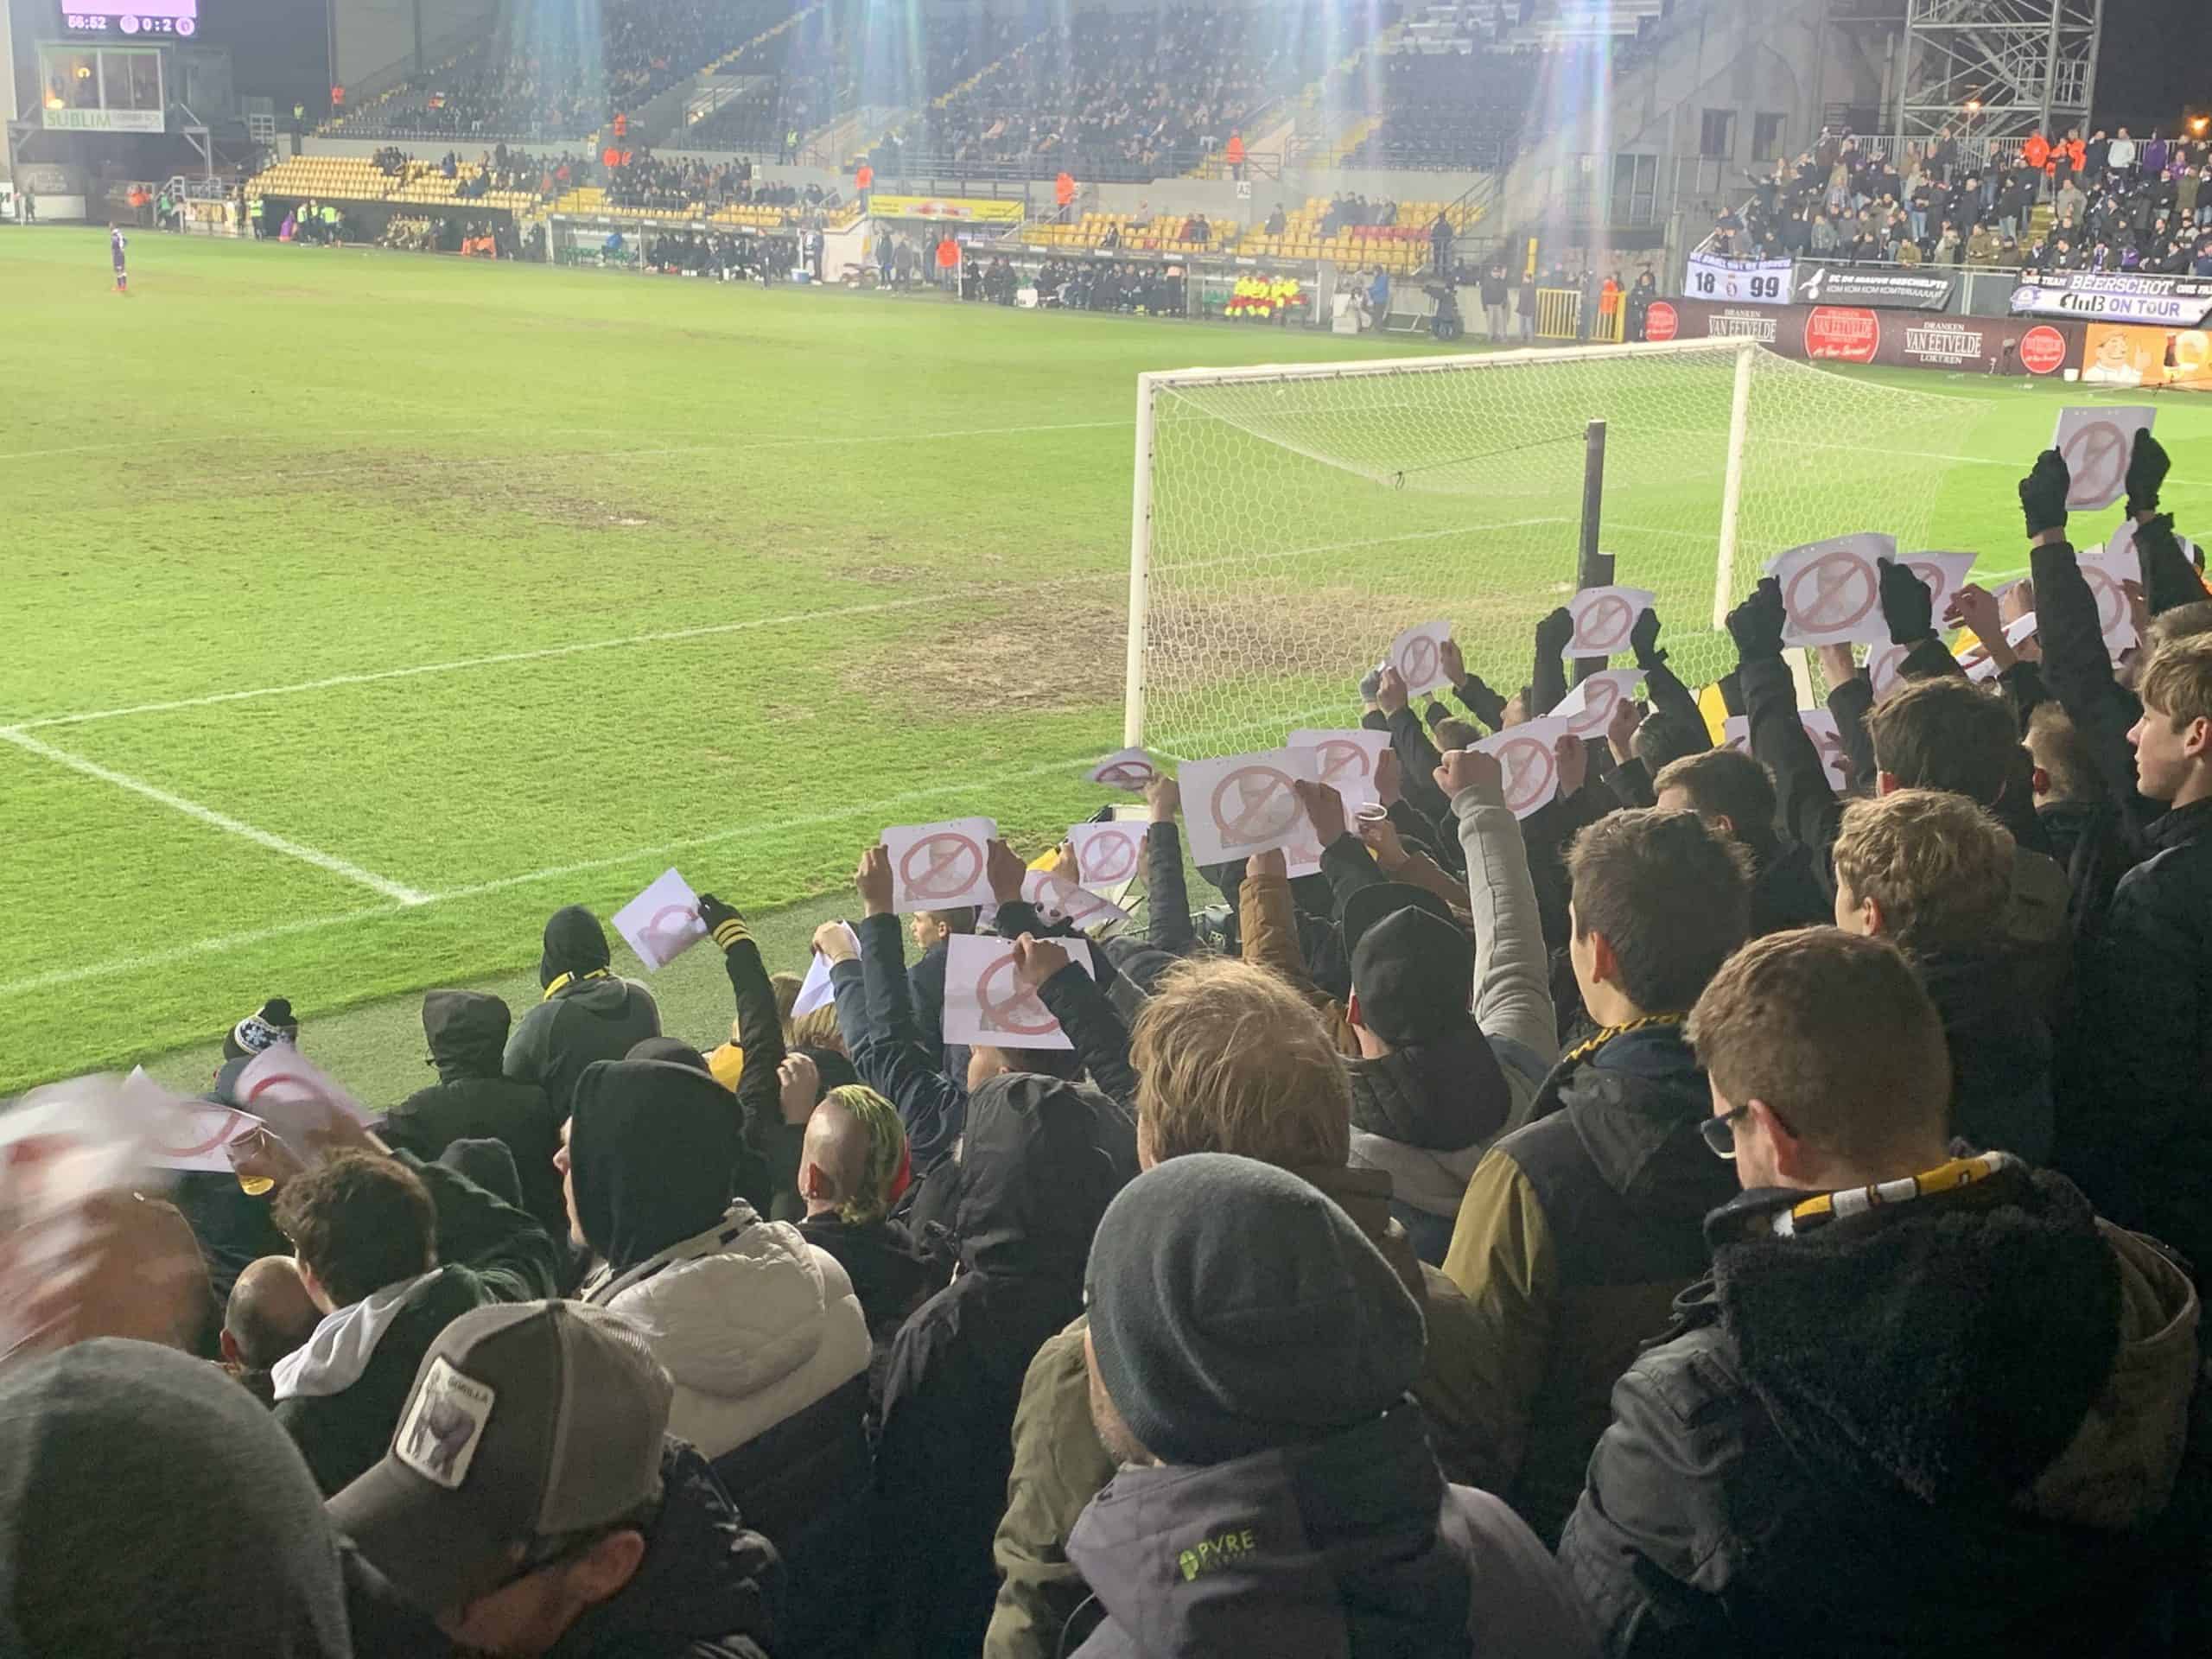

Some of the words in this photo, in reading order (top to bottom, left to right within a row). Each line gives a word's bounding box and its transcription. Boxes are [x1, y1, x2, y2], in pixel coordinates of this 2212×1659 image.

[46, 111, 112, 129] SUBLIM
[1695, 271, 1715, 294] 18
[1750, 276, 1780, 298] 99
[2042, 276, 2067, 287] TEAM
[2069, 275, 2176, 295] BEERSCHOT
[2108, 297, 2131, 314] ON
[2138, 299, 2181, 317] TOUR
[1709, 318, 1727, 338] VAN
[1729, 319, 1777, 340] EETVELDE
[1923, 321, 1965, 332] DRANKEN
[1906, 331, 1927, 351] VAN
[1929, 333, 1982, 354] EETVELDE
